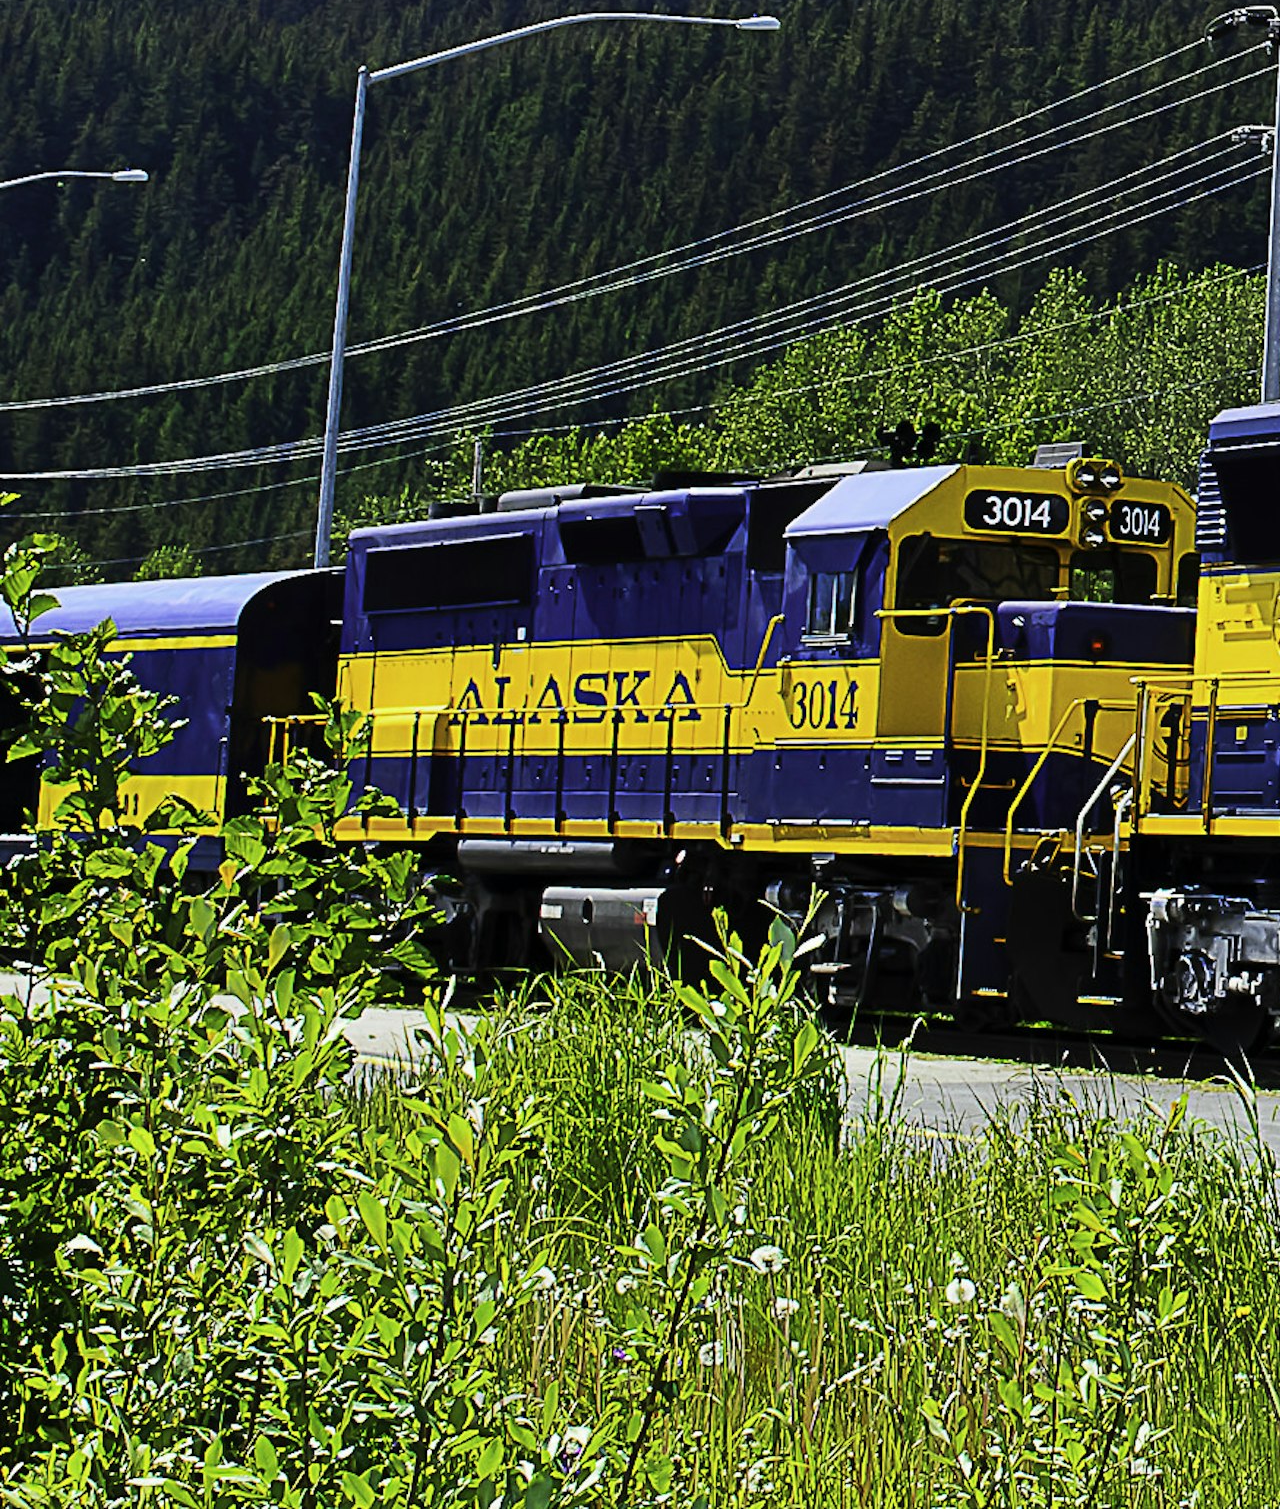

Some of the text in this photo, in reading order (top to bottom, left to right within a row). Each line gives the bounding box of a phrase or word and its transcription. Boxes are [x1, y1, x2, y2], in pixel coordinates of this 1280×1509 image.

[983, 496, 1051, 528] 3014
[1120, 506, 1160, 537] 3014
[449, 670, 701, 725] ALASKA
[791, 681, 859, 729] 3014
